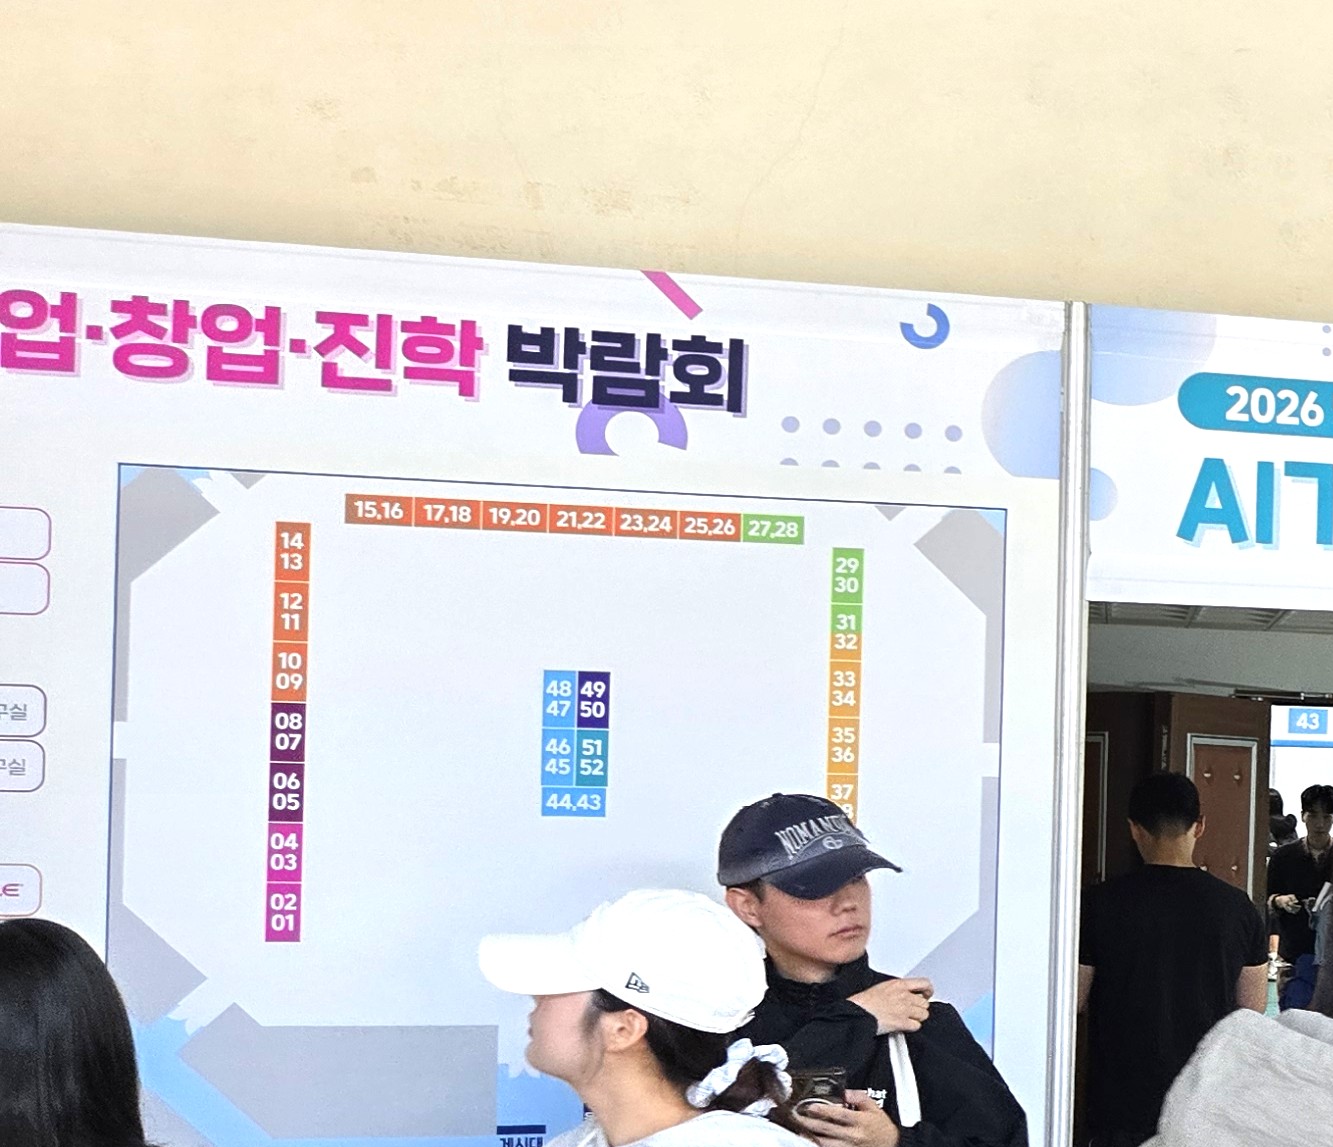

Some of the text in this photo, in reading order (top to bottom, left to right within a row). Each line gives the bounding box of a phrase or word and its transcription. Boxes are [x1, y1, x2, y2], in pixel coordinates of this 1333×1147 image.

[506, 325, 745, 416] 박람회
[1224, 385, 1325, 427] 2026
[280, 532, 304, 550] 14
[280, 552, 303, 571] 13
[835, 557, 860, 575] 29
[834, 576, 859, 594] 30
[279, 592, 303, 610] 12
[280, 613, 301, 631] 11
[836, 613, 857, 631] 31
[834, 633, 858, 651] 32
[277, 652, 302, 670] 10
[275, 672, 303, 690] 09
[832, 670, 857, 688] 33
[545, 680, 573, 698] 48
[580, 681, 607, 699] 49
[831, 689, 856, 707] 34
[546, 700, 572, 718] 47
[580, 701, 606, 719] 50
[274, 712, 303, 730] 08
[1296, 712, 1320, 730] 43
[275, 733, 302, 751] 07
[831, 727, 855, 745] 35
[545, 738, 572, 756] 46
[582, 738, 603, 757] 51
[831, 746, 855, 764] 36
[544, 758, 571, 776] 45
[580, 759, 605, 777] 52
[273, 772, 301, 790] 06
[831, 784, 854, 801] 37
[272, 793, 300, 811] 05
[839, 803, 854, 820] 8
[270, 832, 299, 850] 04
[270, 853, 298, 871] 03
[270, 893, 297, 911] 02
[271, 914, 295, 932] 01
